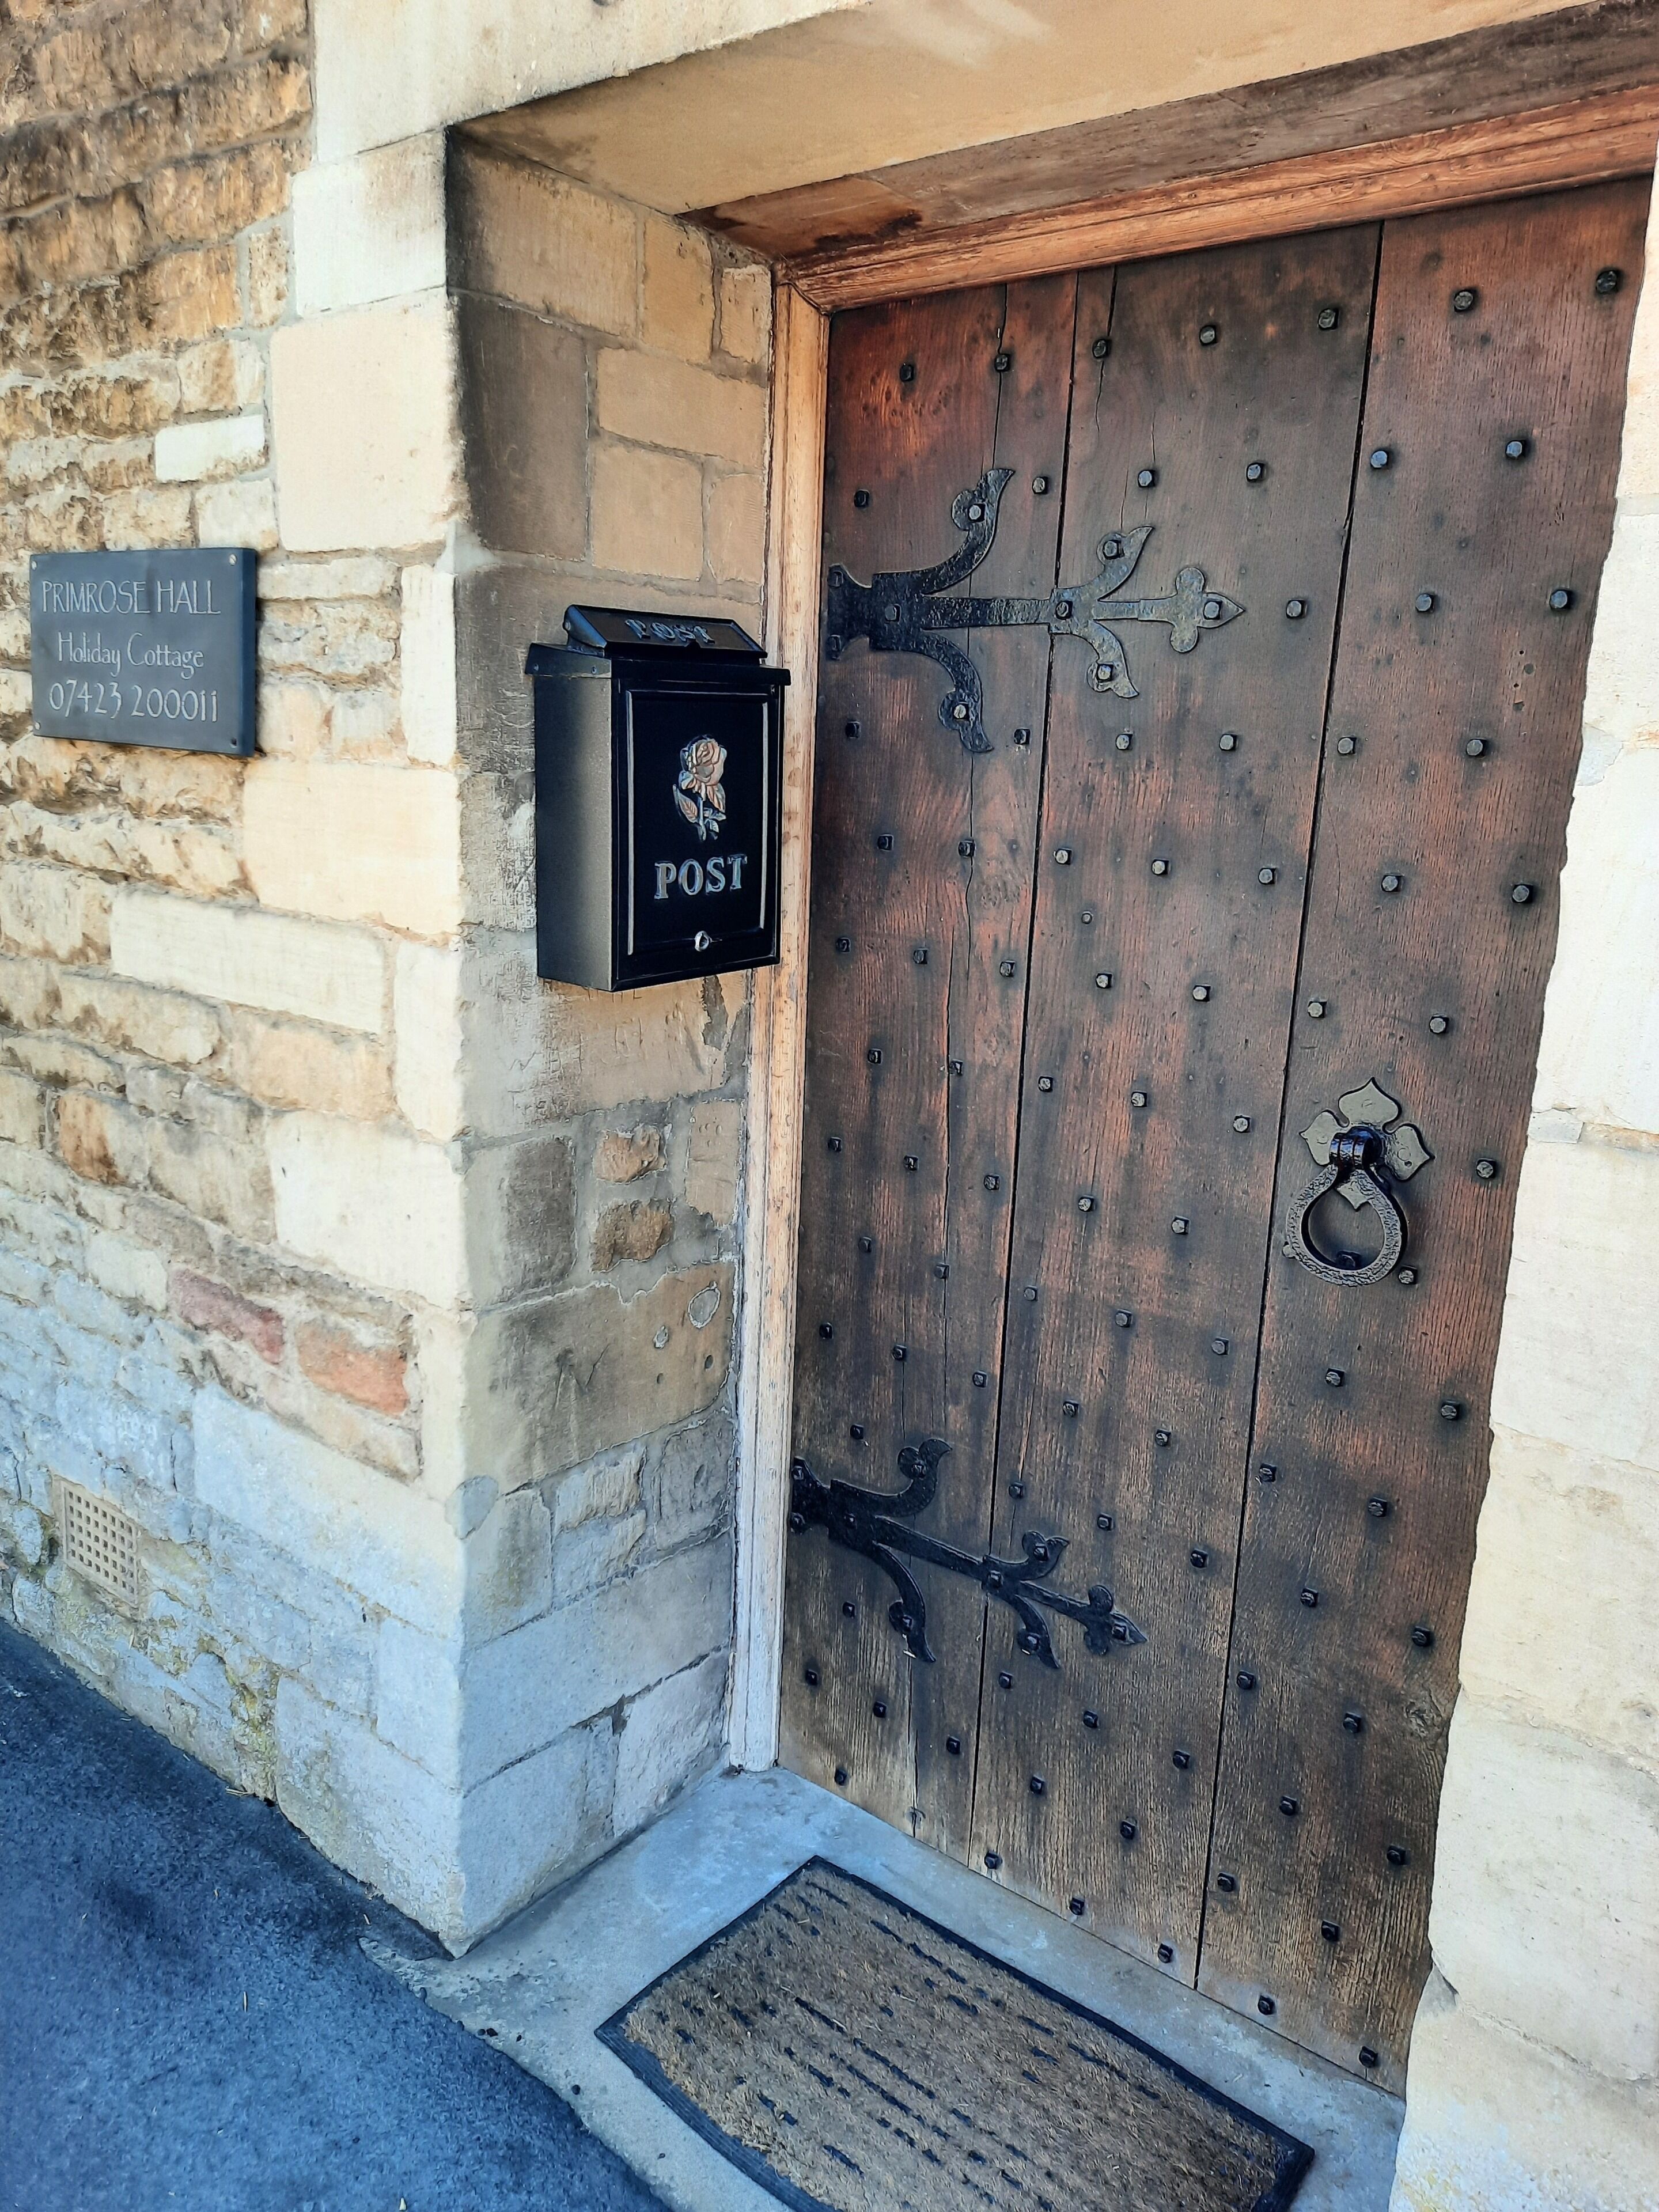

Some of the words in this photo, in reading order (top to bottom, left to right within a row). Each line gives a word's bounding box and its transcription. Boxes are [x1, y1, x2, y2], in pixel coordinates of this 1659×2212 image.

[41, 579, 150, 614] PRIMROSE
[156, 579, 221, 615] HALL
[625, 619, 715, 644] POST
[58, 631, 121, 677] Holiday
[127, 632, 204, 680] Cottage
[48, 679, 122, 719] 07423
[131, 684, 218, 722] 200011
[654, 854, 747, 900] POST
